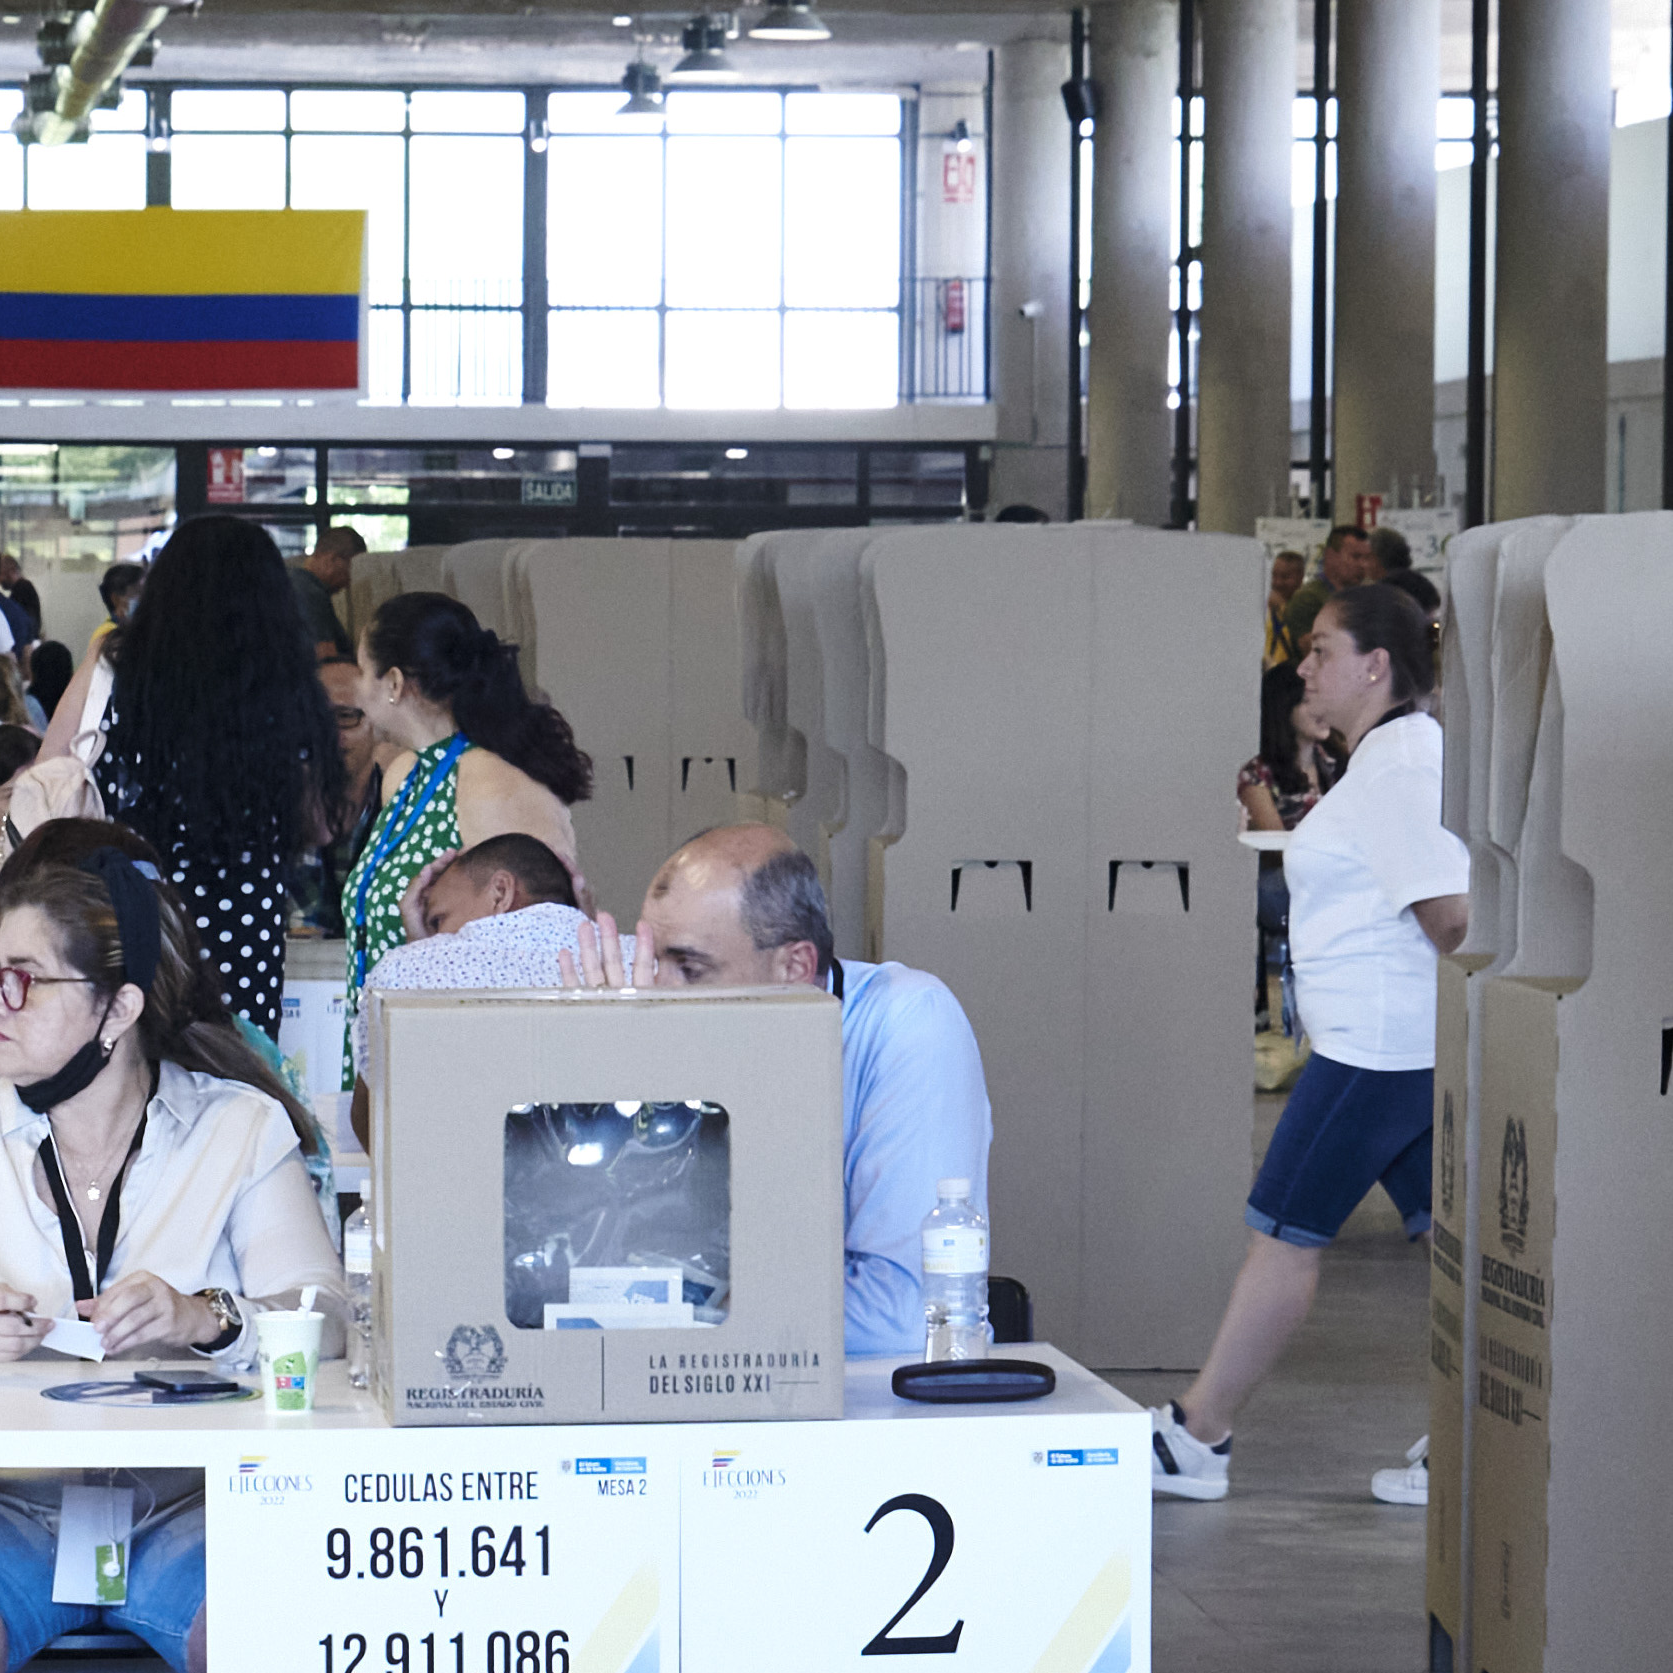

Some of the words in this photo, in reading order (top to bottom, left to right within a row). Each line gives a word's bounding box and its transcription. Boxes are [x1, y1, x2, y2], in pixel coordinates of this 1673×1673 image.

[649, 1354, 667, 1369] LA
[679, 1351, 820, 1369] REGISTRADURÍA
[405, 1383, 544, 1400] REGISTRADURÍA
[649, 1374, 680, 1395] DEL
[684, 1374, 735, 1394] SIGLO
[743, 1373, 771, 1393] XXI
[344, 1472, 453, 1503] CEDULAS
[462, 1471, 539, 1502] ENTRE
[598, 1480, 635, 1496] MESA
[639, 1479, 647, 1495] 2
[326, 1524, 551, 1580] 9.861.641
[861, 1492, 965, 1656] 2
[434, 1590, 449, 1618] Y
